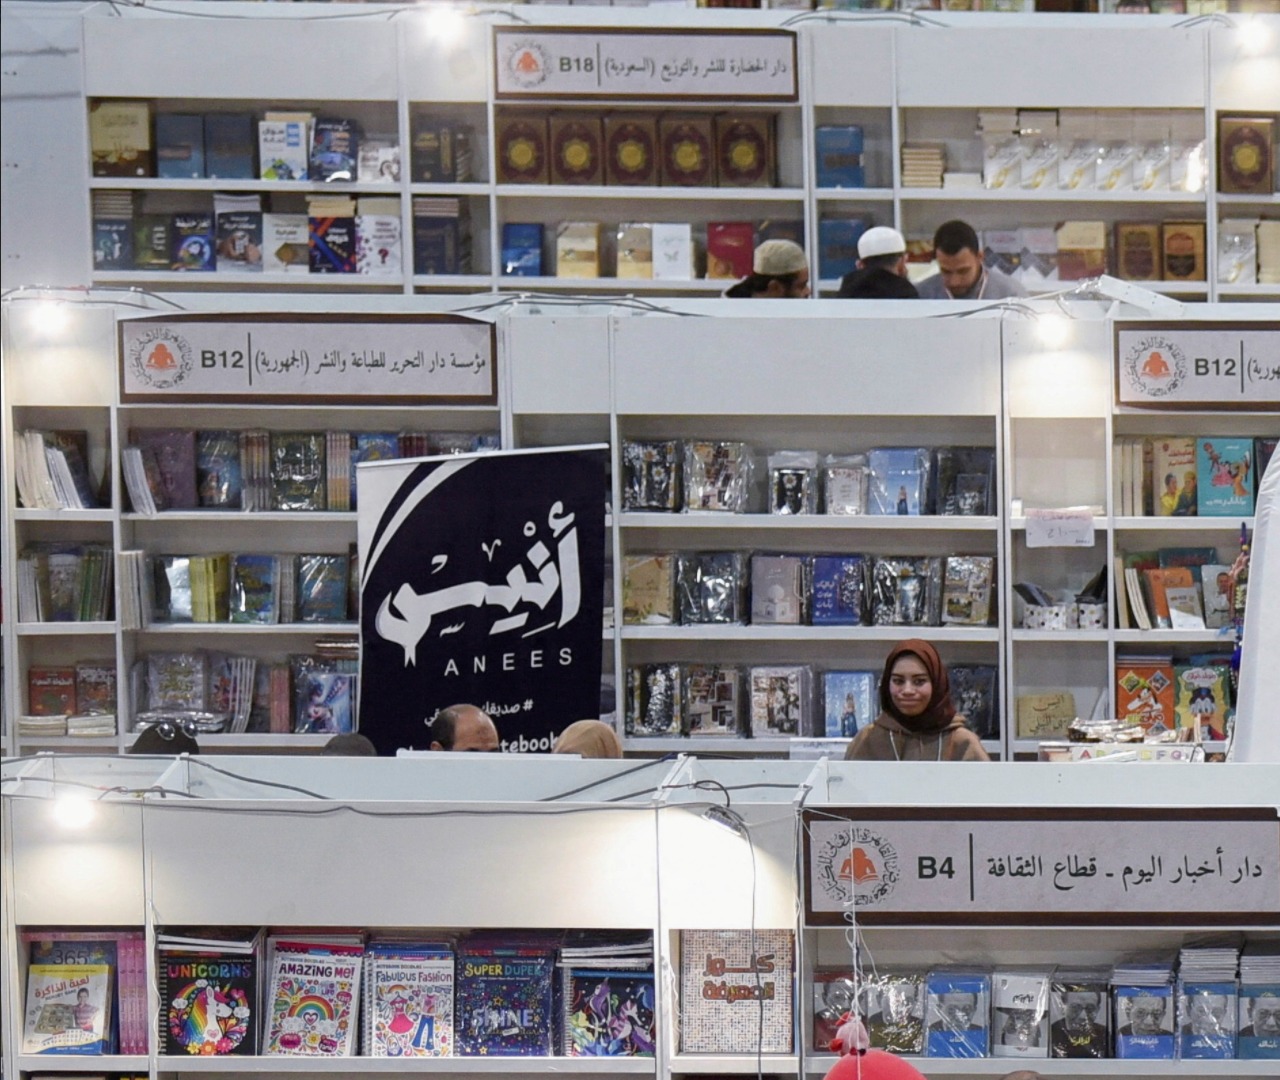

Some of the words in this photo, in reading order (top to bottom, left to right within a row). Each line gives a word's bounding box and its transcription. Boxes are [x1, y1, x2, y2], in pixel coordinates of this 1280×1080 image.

[560, 57, 593, 72] B18
[604, 57, 655, 78] (السعودية)
[661, 57, 698, 81] والتوزيع
[703, 57, 725, 78] للنشر
[731, 56, 767, 75] الحضارة
[771, 61, 786, 76] دار
[202, 351, 243, 368] B12
[255, 349, 309, 374] (الجمهورية)
[314, 350, 346, 374] والنشر
[351, 349, 385, 368] للطباعة
[390, 350, 424, 373] التحرير
[429, 357, 445, 372] دار
[452, 351, 485, 372] مؤسسة
[1194, 357, 1236, 376] B12
[444, 647, 572, 676] ANEES
[918, 856, 955, 879] B4
[987, 852, 1043, 877] الثقافة
[1054, 854, 1097, 890] قطاع
[1122, 855, 1162, 890] اليوم
[1172, 846, 1222, 883] أخبار
[1231, 858, 1262, 883] دار
[52, 948, 88, 965] 365
[466, 963, 503, 977] SUPER
[34, 979, 61, 998] الذاكرة
[62, 975, 89, 990] لعبة
